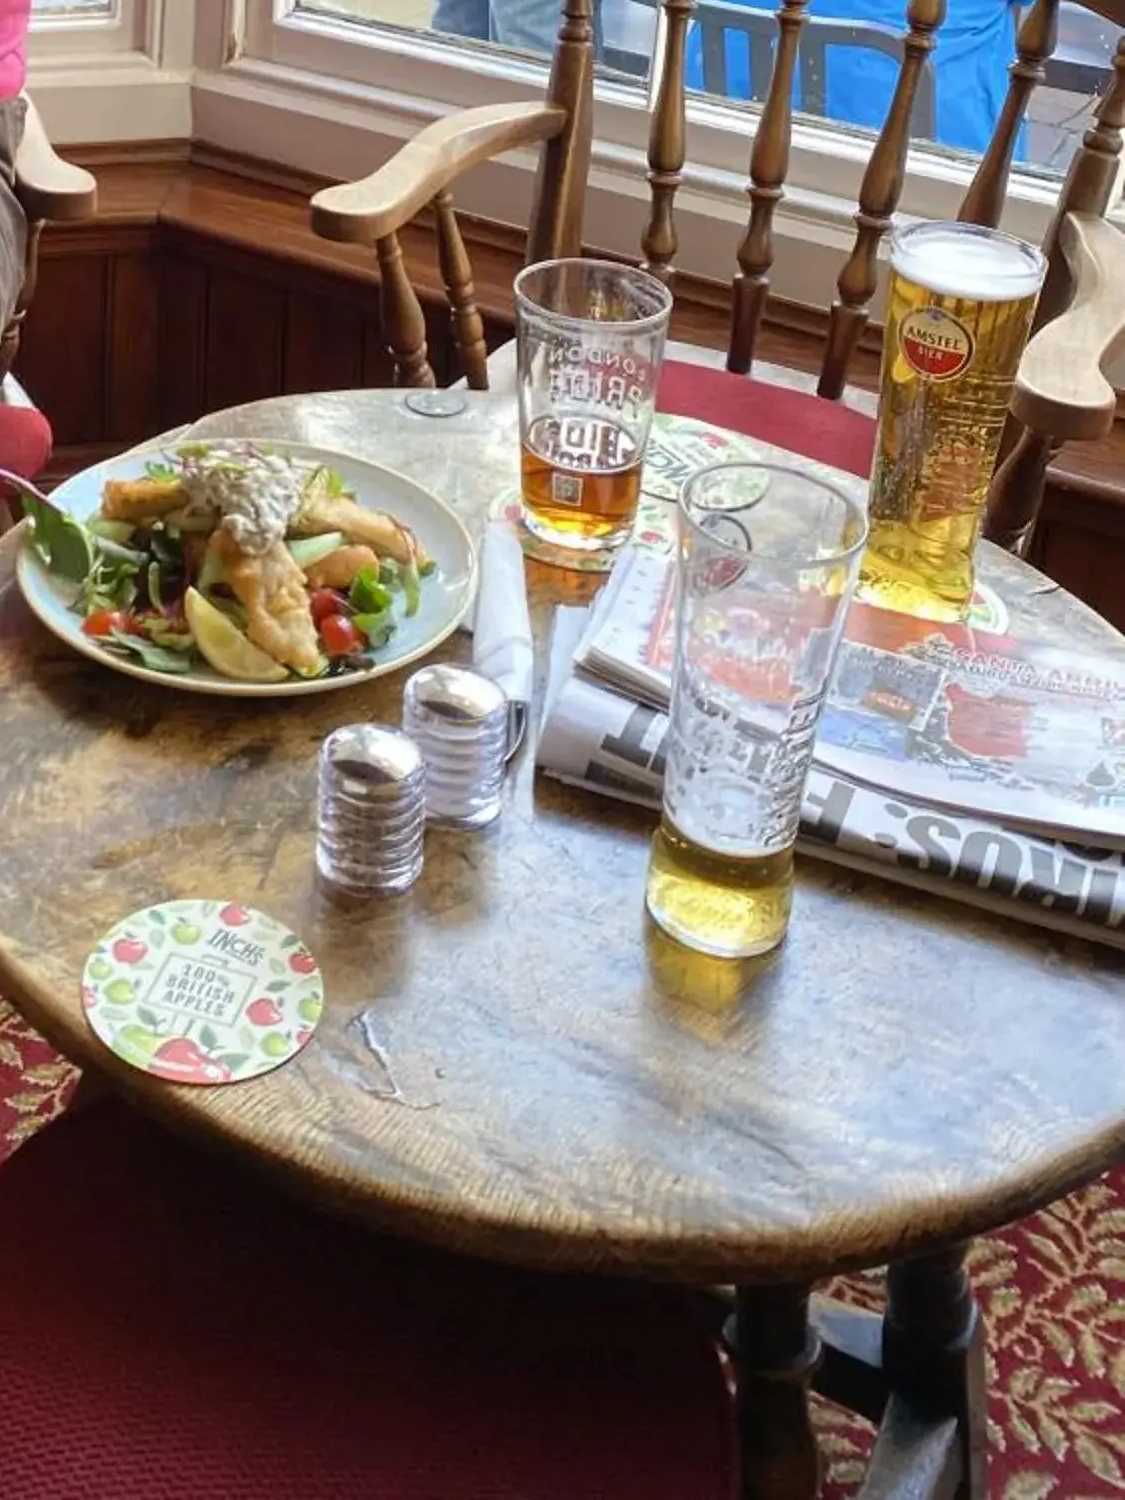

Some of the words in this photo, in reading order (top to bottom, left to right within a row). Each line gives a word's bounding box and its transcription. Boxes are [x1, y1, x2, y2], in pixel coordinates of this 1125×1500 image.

[907, 325, 962, 350] AMSTEL
[918, 345, 943, 361] BIER
[166, 974, 235, 1004] BRITISH
[161, 989, 225, 1017] APPLES
